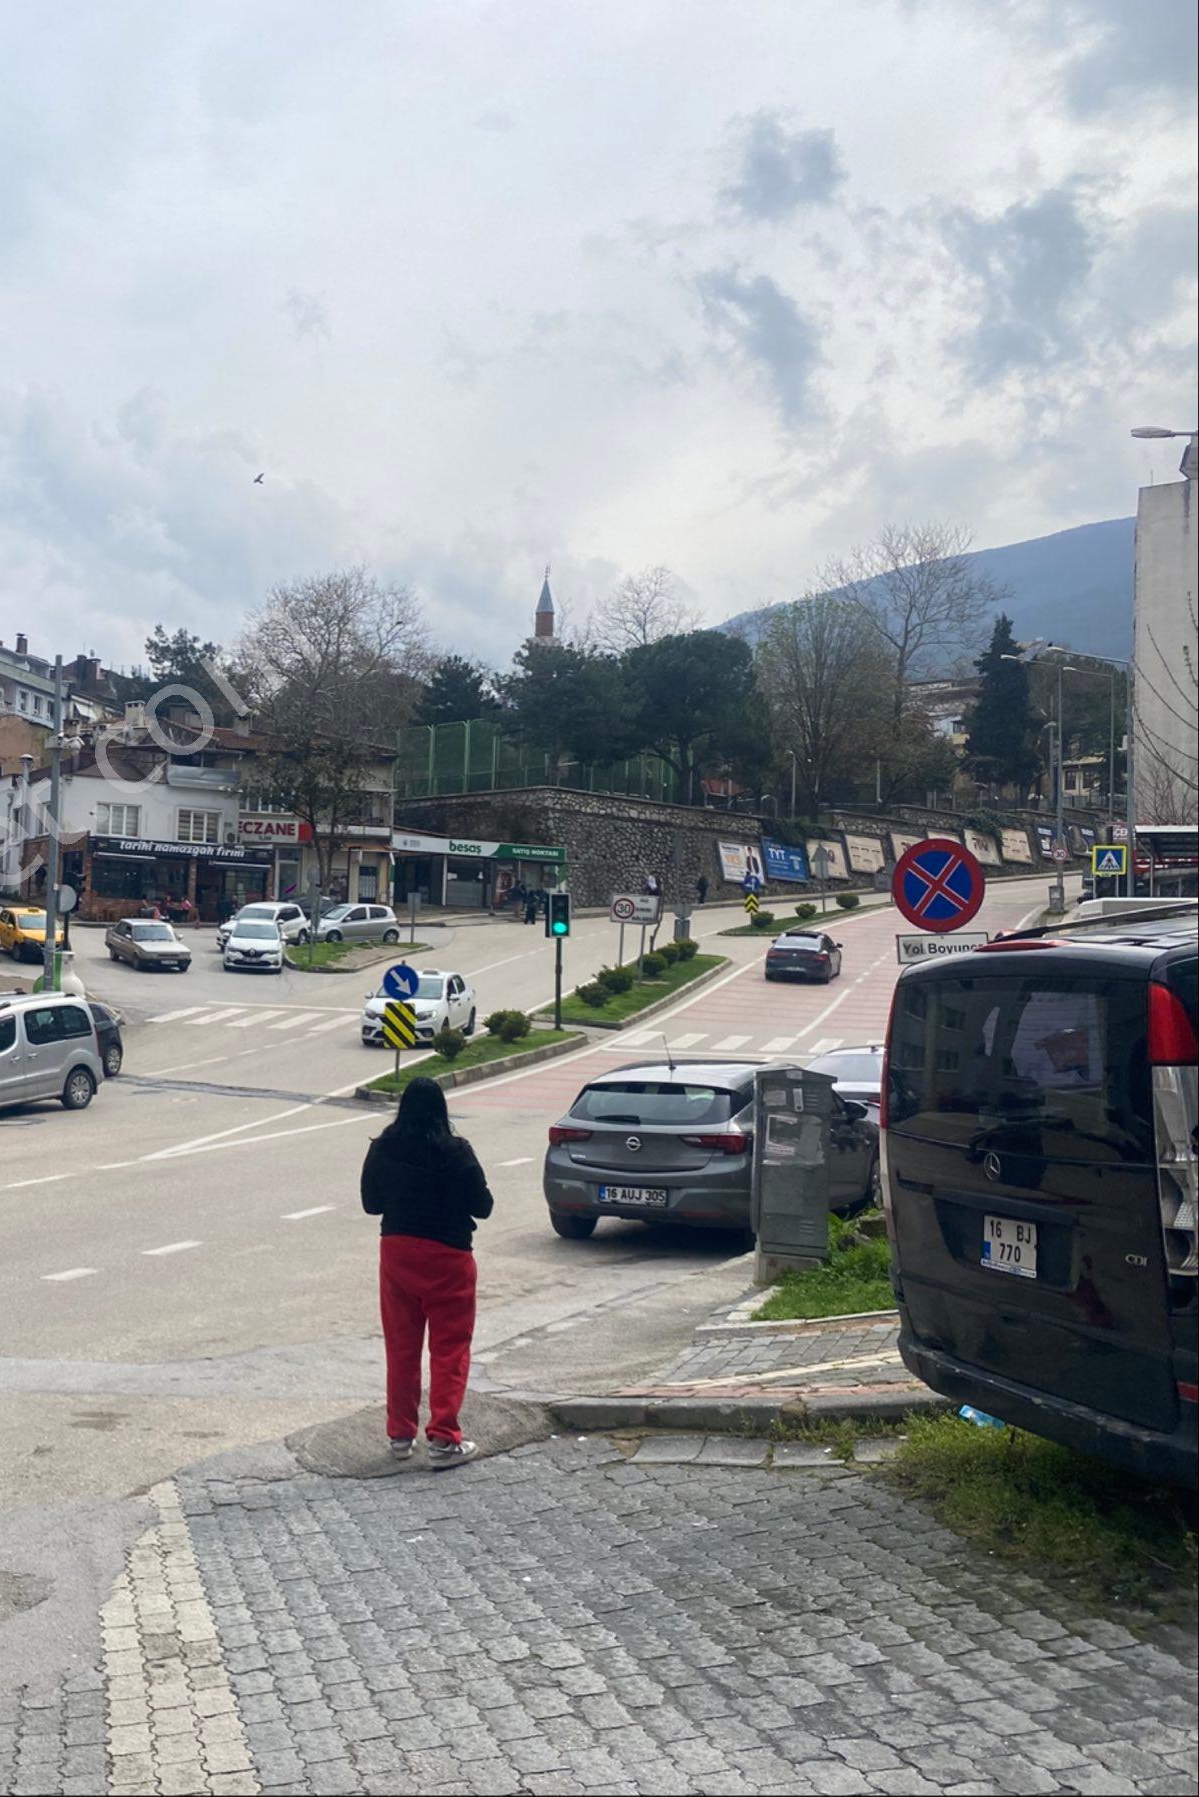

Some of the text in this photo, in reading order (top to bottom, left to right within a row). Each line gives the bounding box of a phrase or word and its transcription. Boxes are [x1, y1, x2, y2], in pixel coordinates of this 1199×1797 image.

[120, 841, 153, 852] tarihi
[154, 843, 214, 857] namazgah
[449, 840, 482, 854] besaş
[617, 903, 631, 914] 30
[903, 943, 924, 955] Yol
[606, 1188, 666, 1202] 16 AUJ 305
[990, 1219, 1031, 1244] 16 BJ
[999, 1243, 1021, 1263] 770
[1124, 1253, 1148, 1267] CDI
